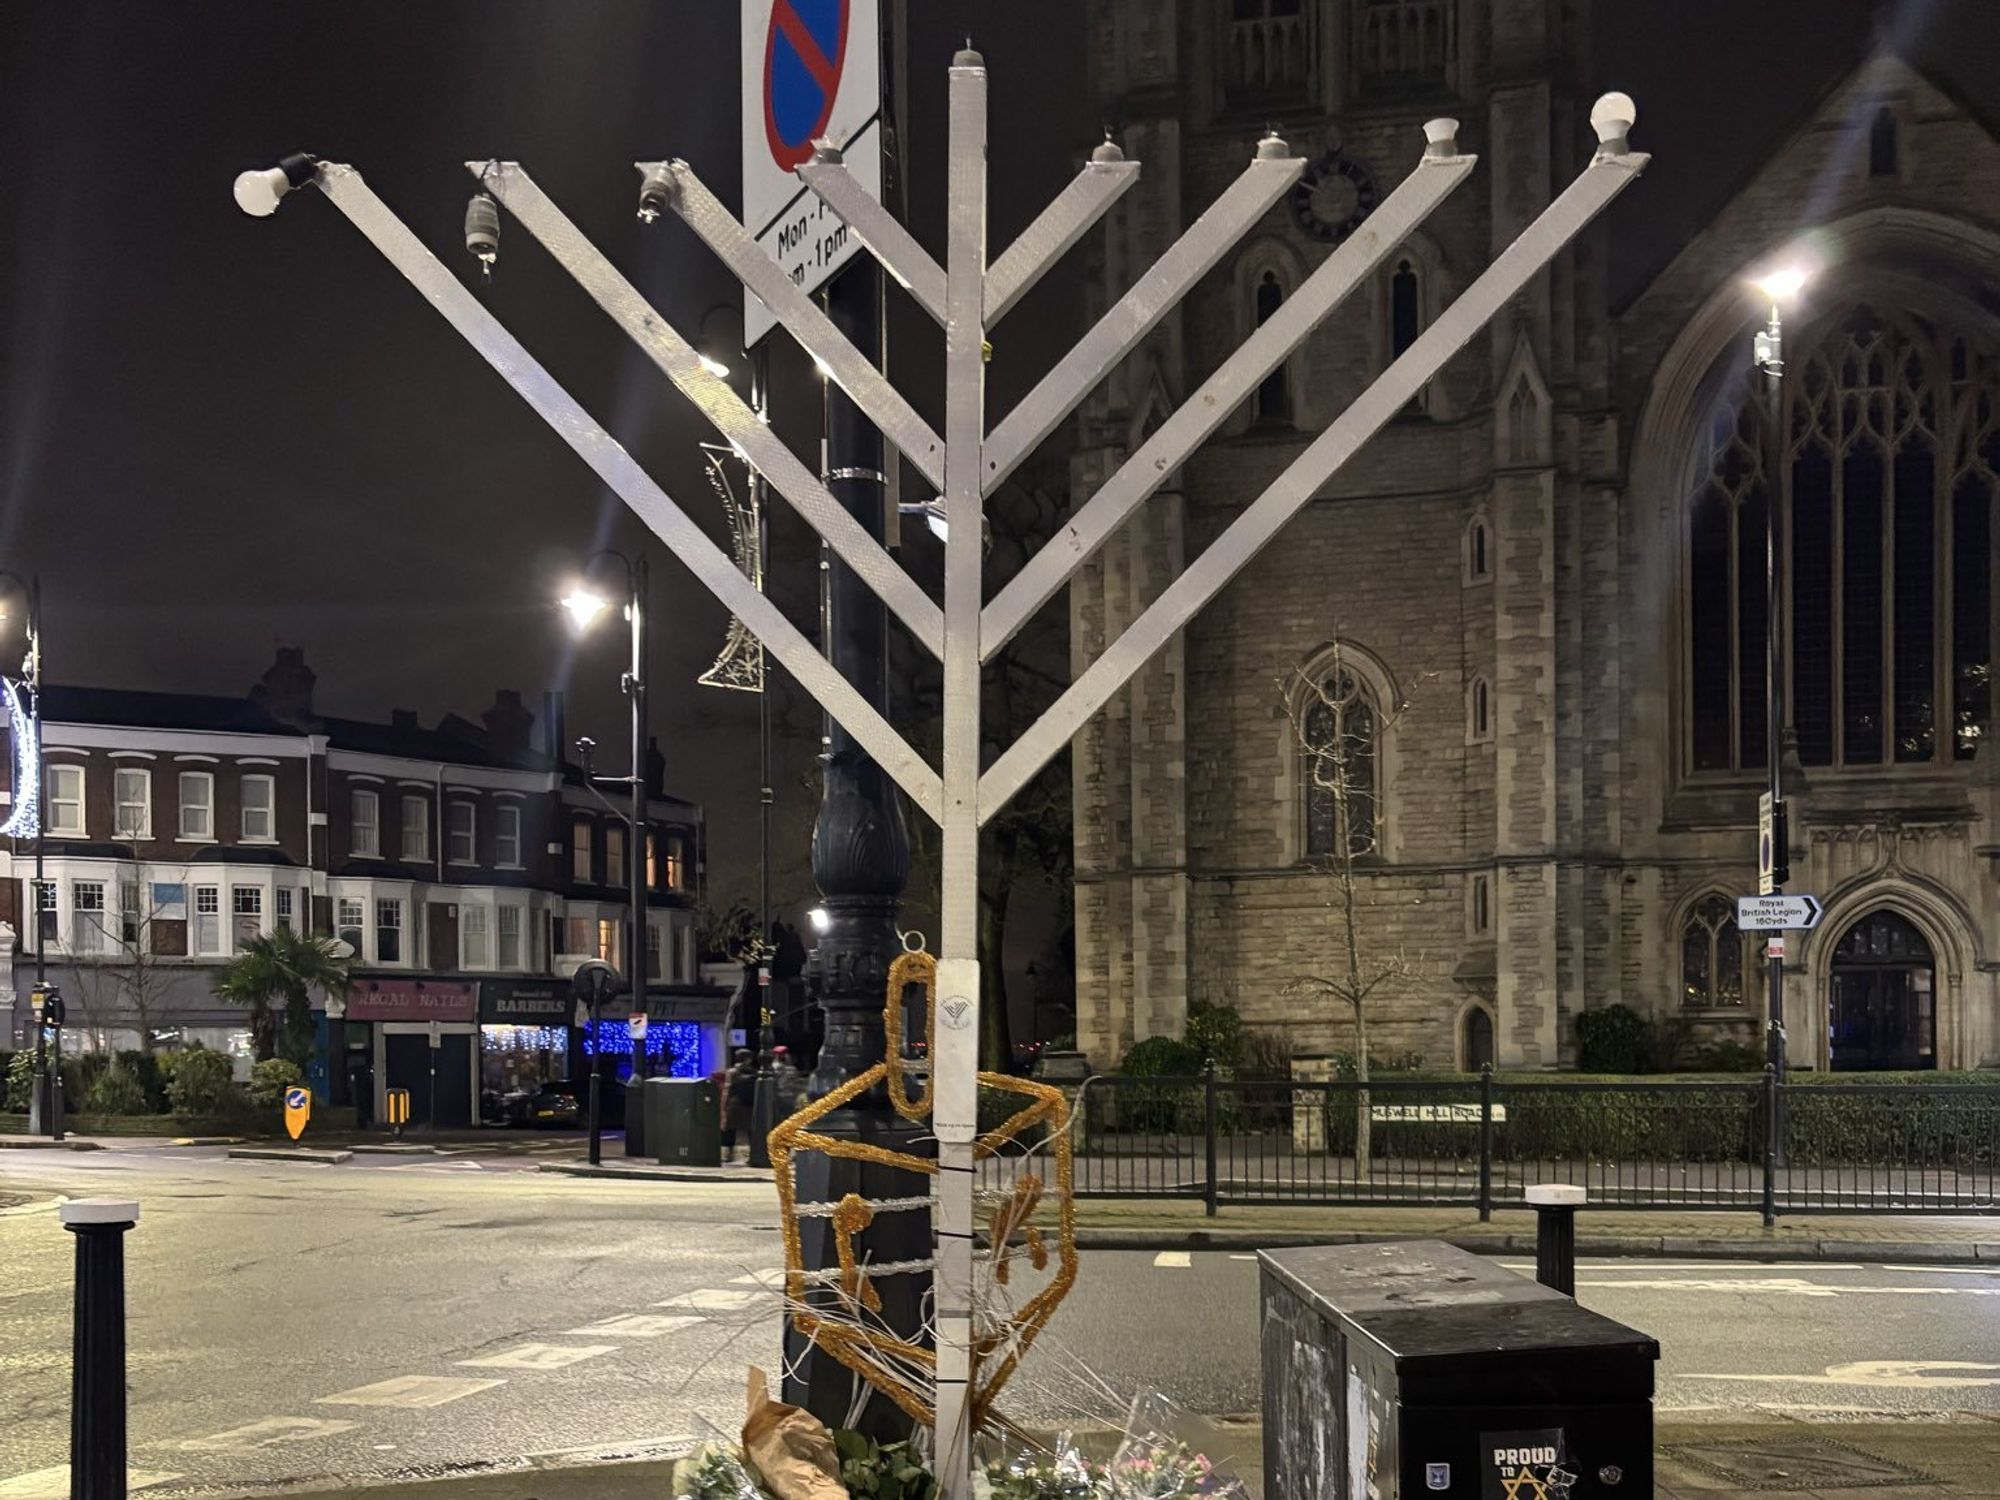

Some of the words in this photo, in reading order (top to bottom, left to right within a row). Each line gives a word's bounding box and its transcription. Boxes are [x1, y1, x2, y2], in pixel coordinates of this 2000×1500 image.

[778, 215, 807, 260] Mon
[1759, 899, 1784, 907] Royal
[1741, 908, 1771, 916] British
[1772, 908, 1802, 917] Legion
[358, 993, 409, 1006] REGAL
[418, 994, 468, 1007] NAILS
[496, 999, 566, 1013] BARBERS
[1426, 1107, 1448, 1118] HLL
[1493, 1446, 1557, 1466] PROUD
[1500, 1466, 1515, 1477] TO
